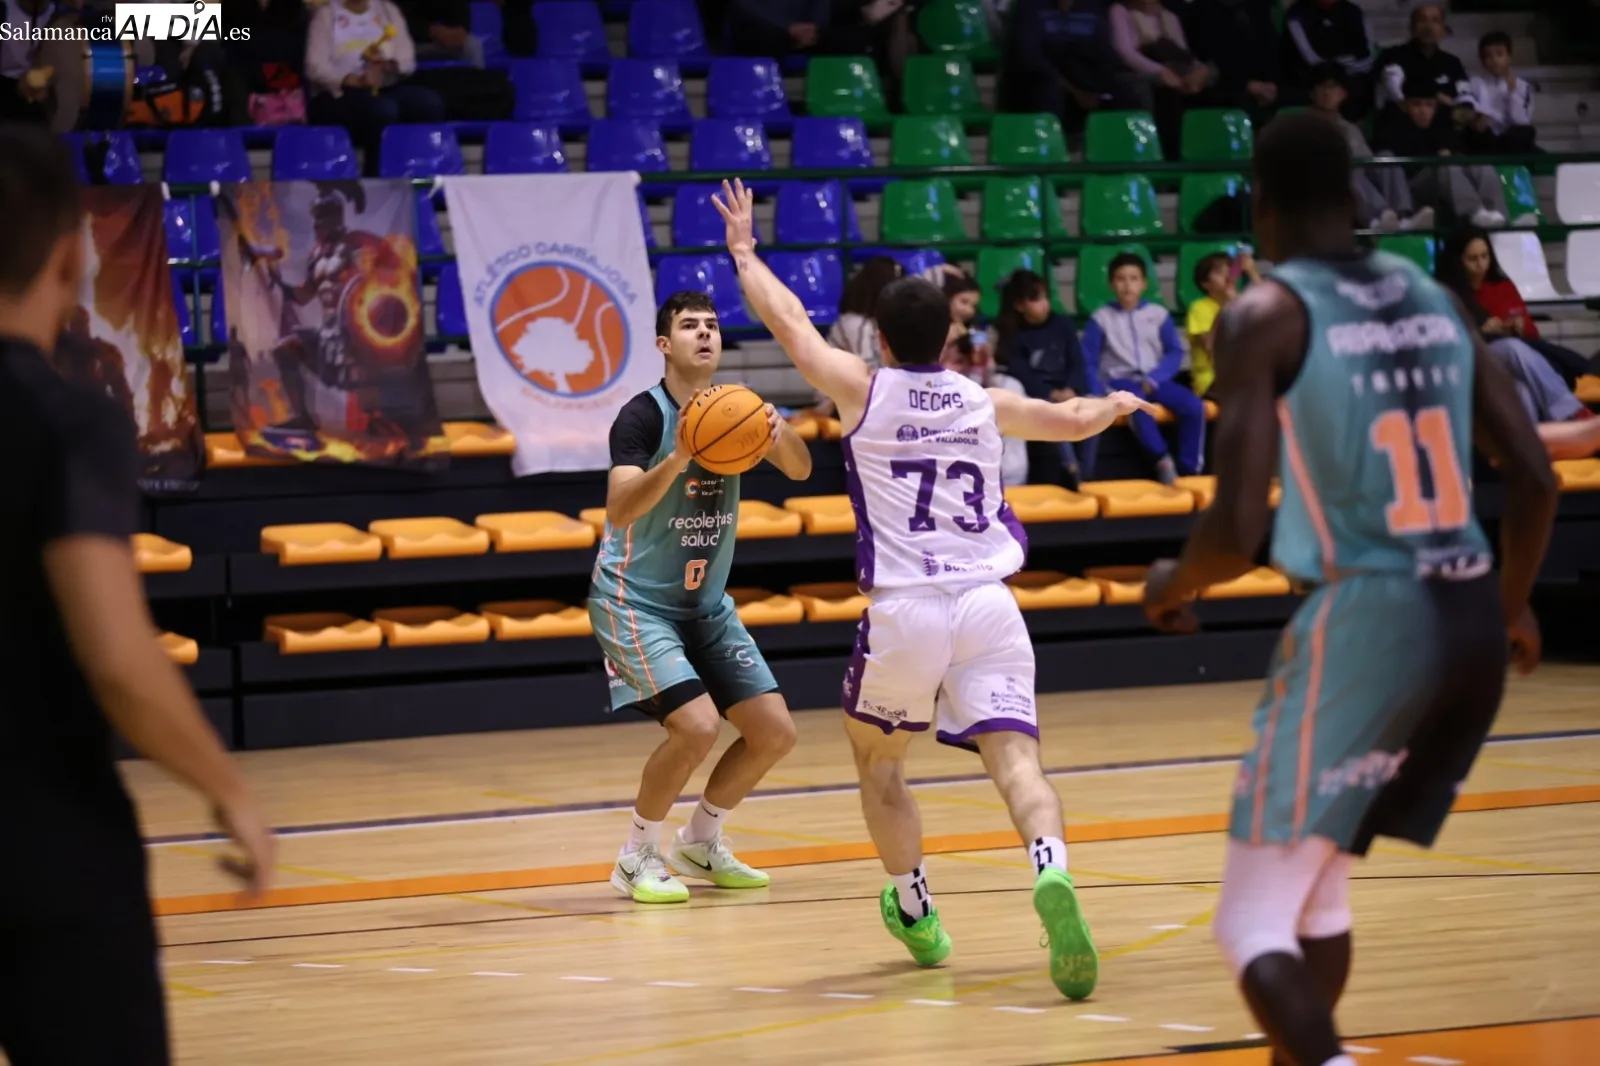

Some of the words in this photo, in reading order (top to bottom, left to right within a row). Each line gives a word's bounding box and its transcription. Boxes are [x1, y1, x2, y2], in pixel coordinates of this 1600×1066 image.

[909, 389, 964, 411] DECAS
[1370, 406, 1470, 535] 11
[890, 459, 990, 533] 73
[668, 510, 733, 529] recoletas
[681, 528, 720, 547] salud
[1034, 846, 1053, 866] 11
